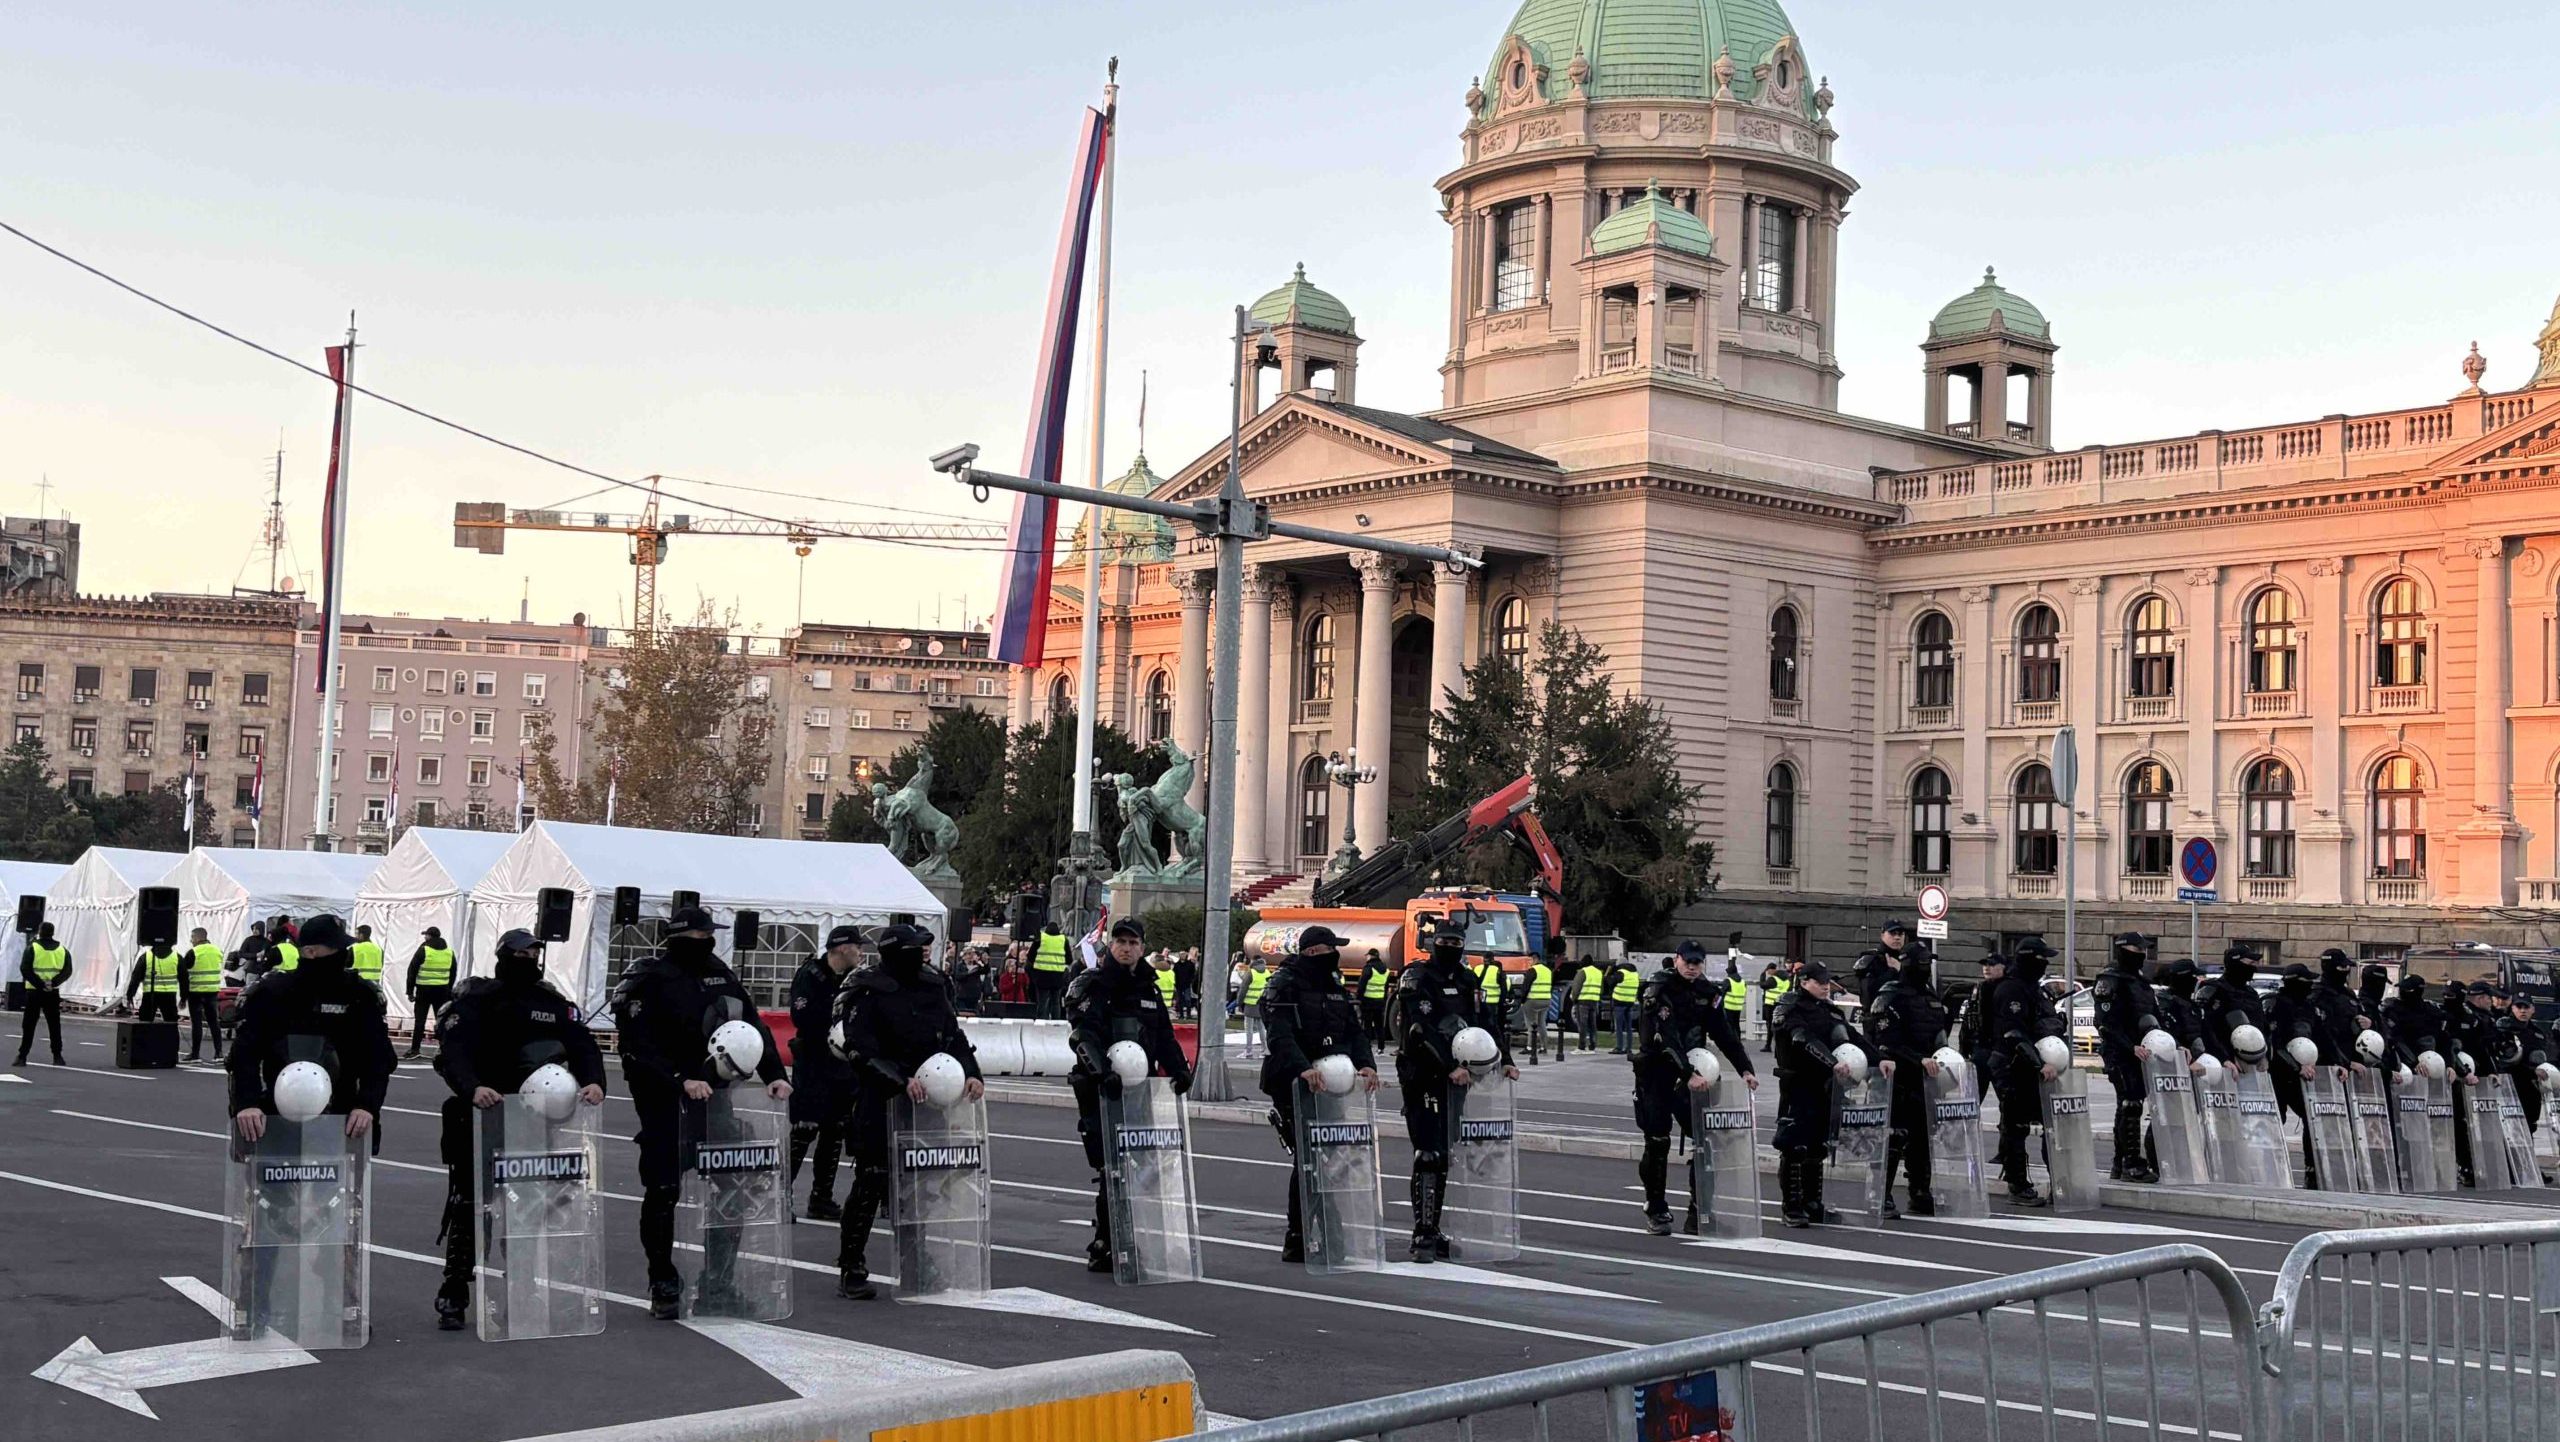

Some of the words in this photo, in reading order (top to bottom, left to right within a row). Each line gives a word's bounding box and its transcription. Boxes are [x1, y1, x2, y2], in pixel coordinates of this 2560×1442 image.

[494, 1155, 589, 1179] ПОЛИЦИЈА
[699, 1147, 780, 1170] ПОЛИЦИЈА
[905, 1147, 980, 1168] ПОЛИЦИЈА
[265, 1166, 337, 1181] ПОЛИЦИЈА
